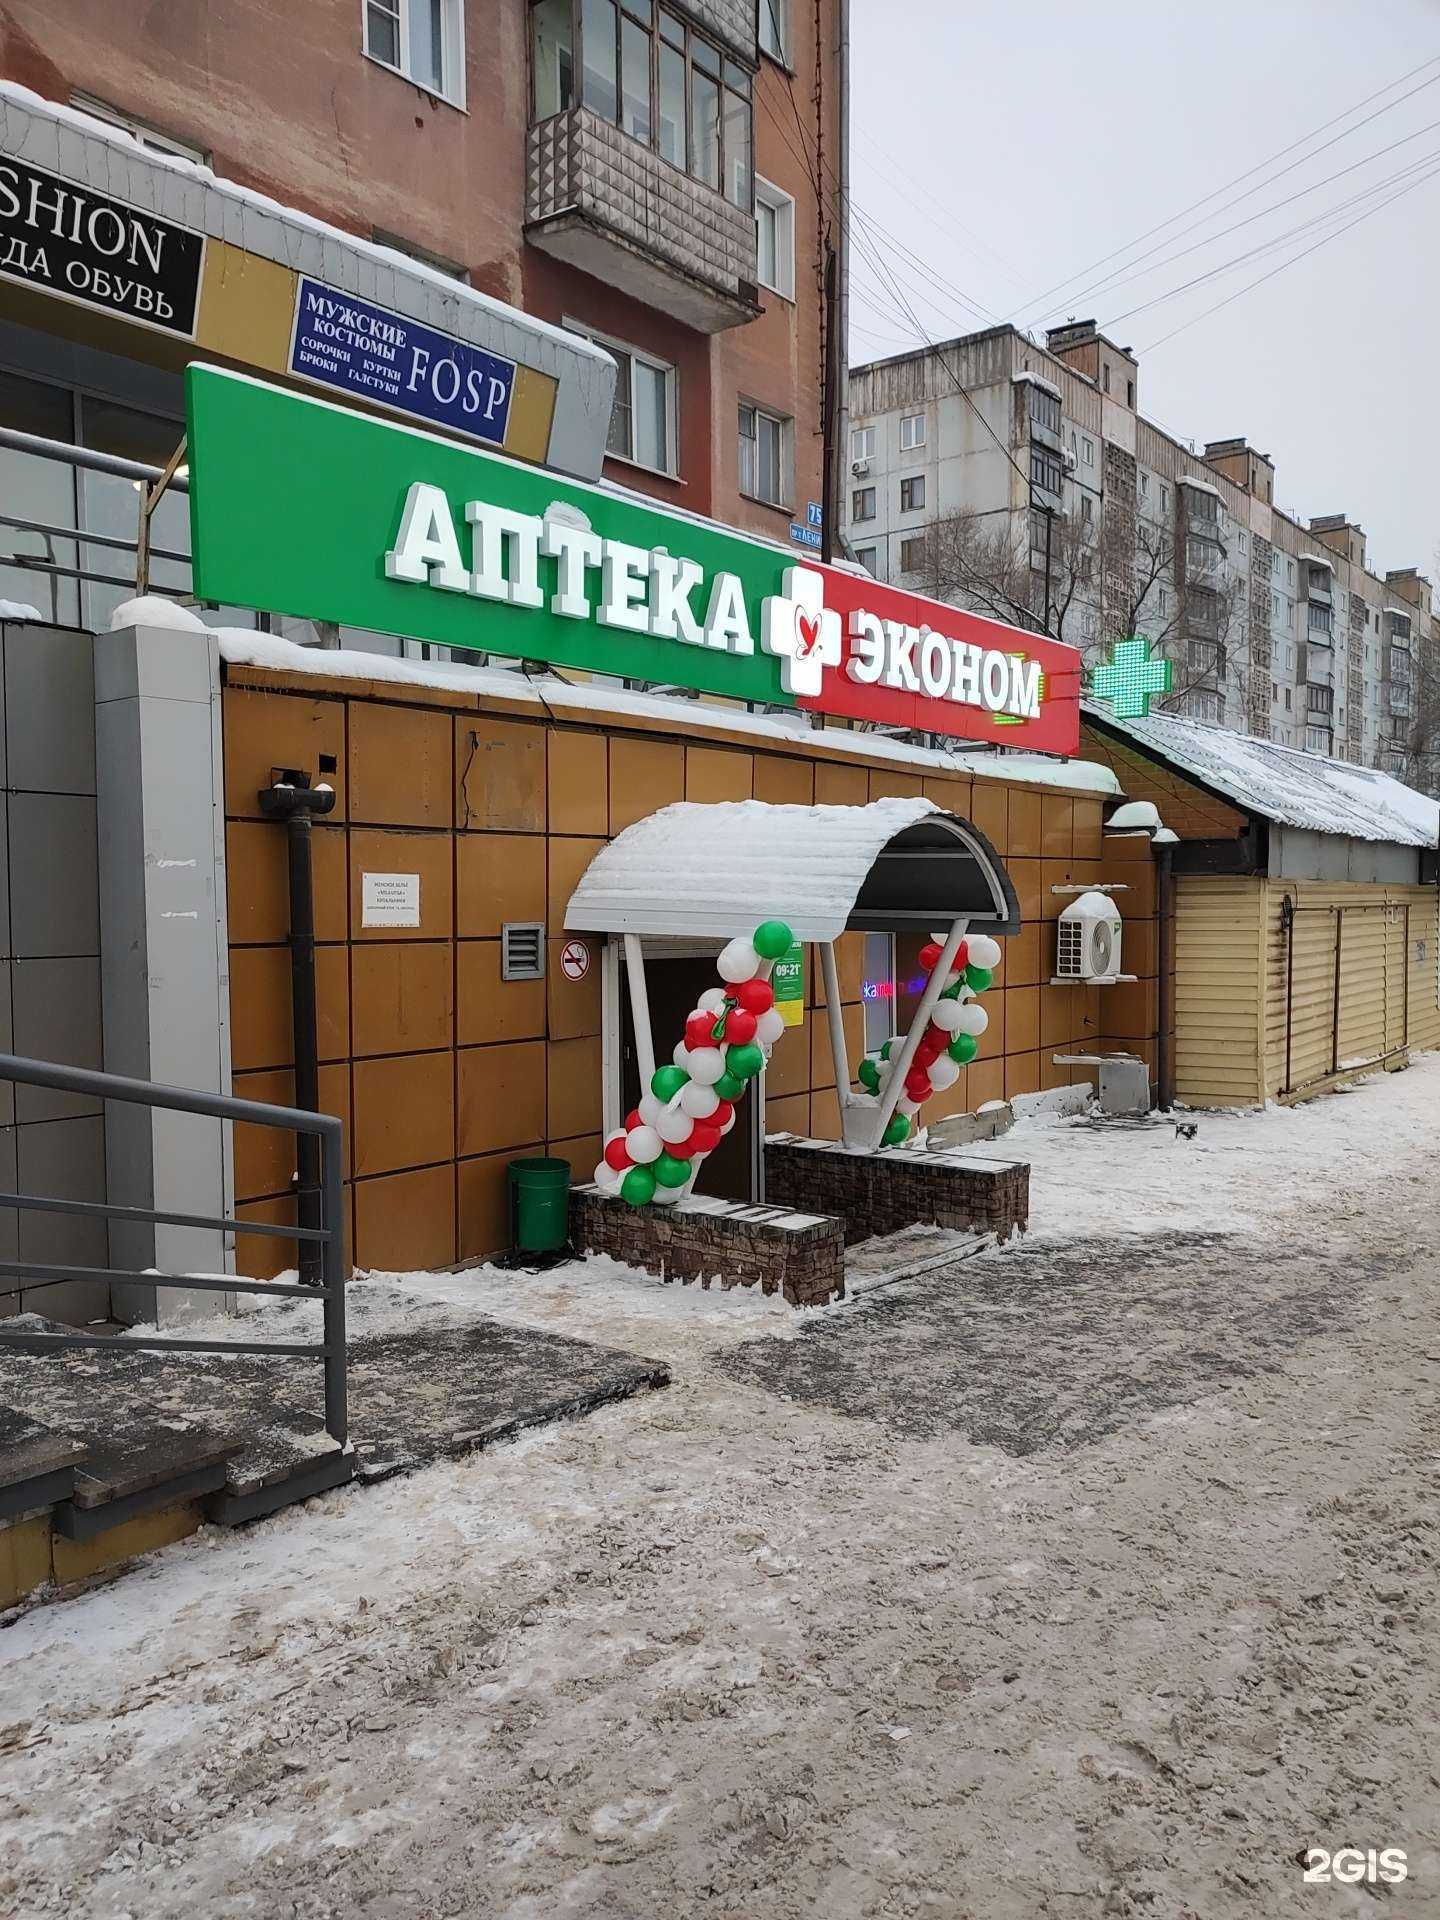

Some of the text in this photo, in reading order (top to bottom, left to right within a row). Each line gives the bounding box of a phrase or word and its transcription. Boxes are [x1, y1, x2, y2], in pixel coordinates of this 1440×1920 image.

[0, 166, 167, 274] SHION
[0, 233, 173, 319] ДА ОБУВЬ
[306, 293, 407, 348] МУЖСКИЕ
[313, 318, 396, 361] КОСТЮМЫ
[300, 336, 401, 382] СОРОЧКИ КУРТКИ
[300, 351, 399, 396] БРЮКИ ГАЛСТУКИ
[406, 346, 506, 421] FOSP
[385, 482, 754, 656] АПТЕКА
[845, 609, 1042, 718] ЭКОНОМ
